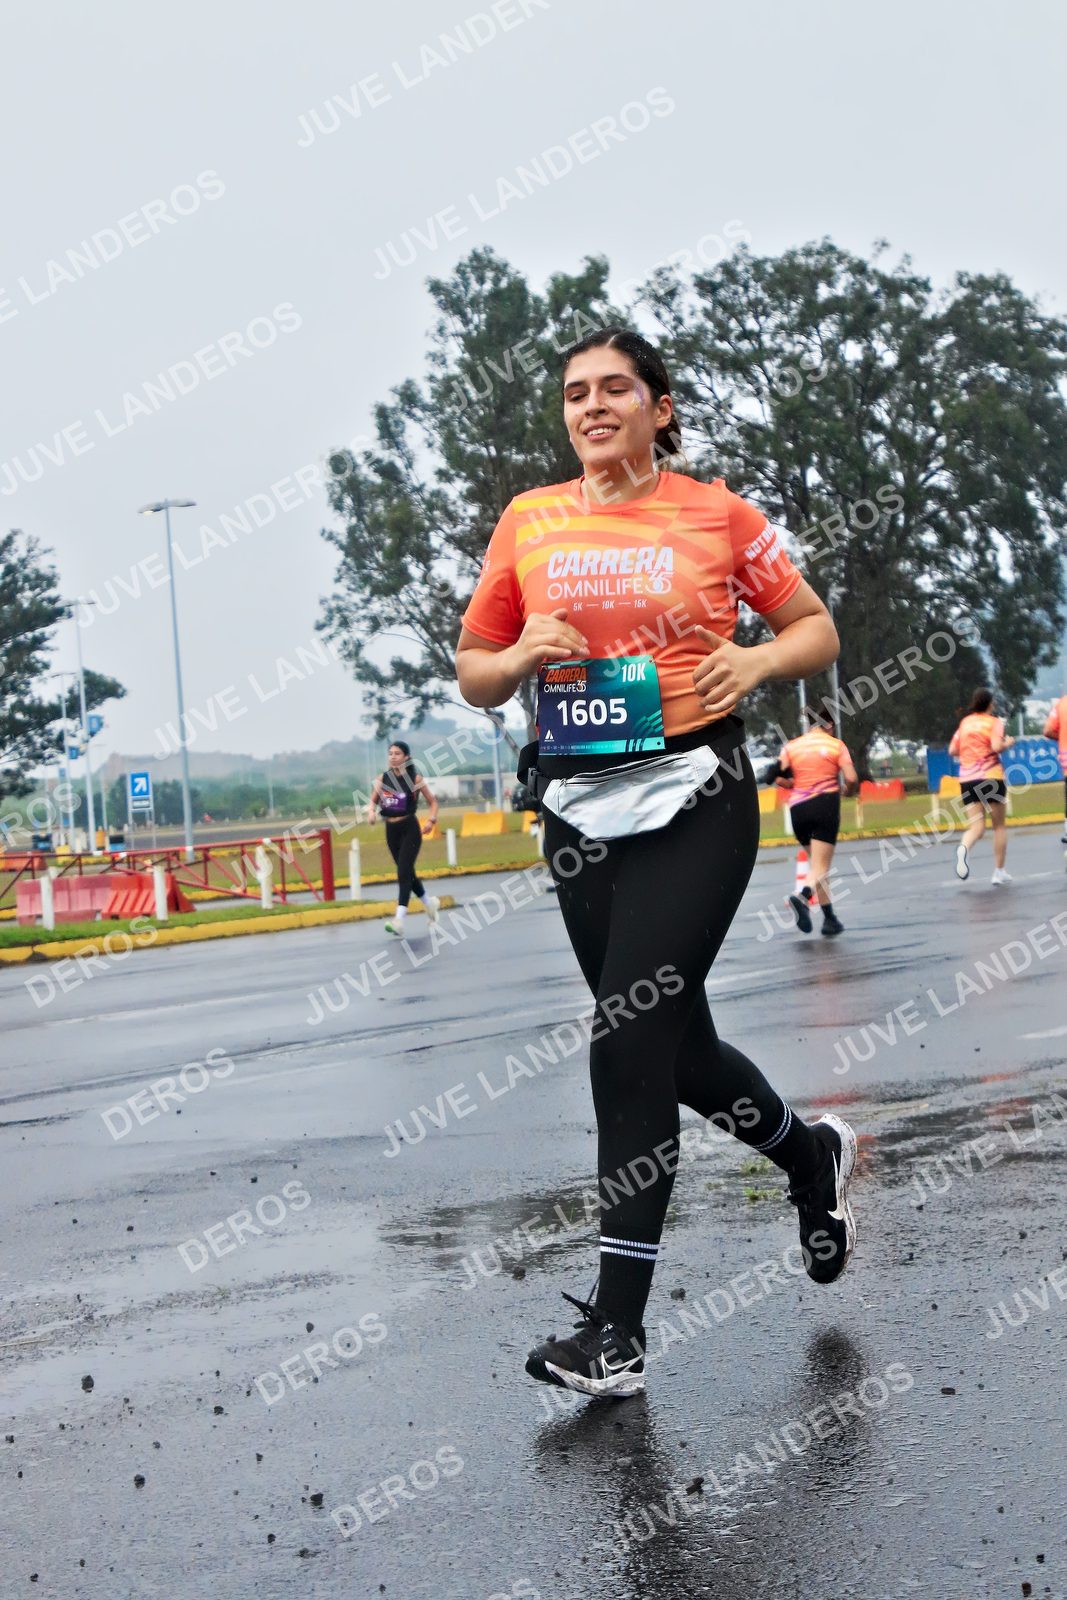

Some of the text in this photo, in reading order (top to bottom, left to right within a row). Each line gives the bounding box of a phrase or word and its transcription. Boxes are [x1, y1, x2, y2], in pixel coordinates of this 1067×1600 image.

[547, 546, 673, 579] CARRERA
[547, 578, 643, 600] OMNILIFE
[573, 599, 647, 612] 5K 10K 15K
[545, 667, 587, 682] CARRERA
[621, 663, 646, 682] 10K
[544, 683, 576, 693] OMNILIFE
[557, 697, 628, 726] 1605
